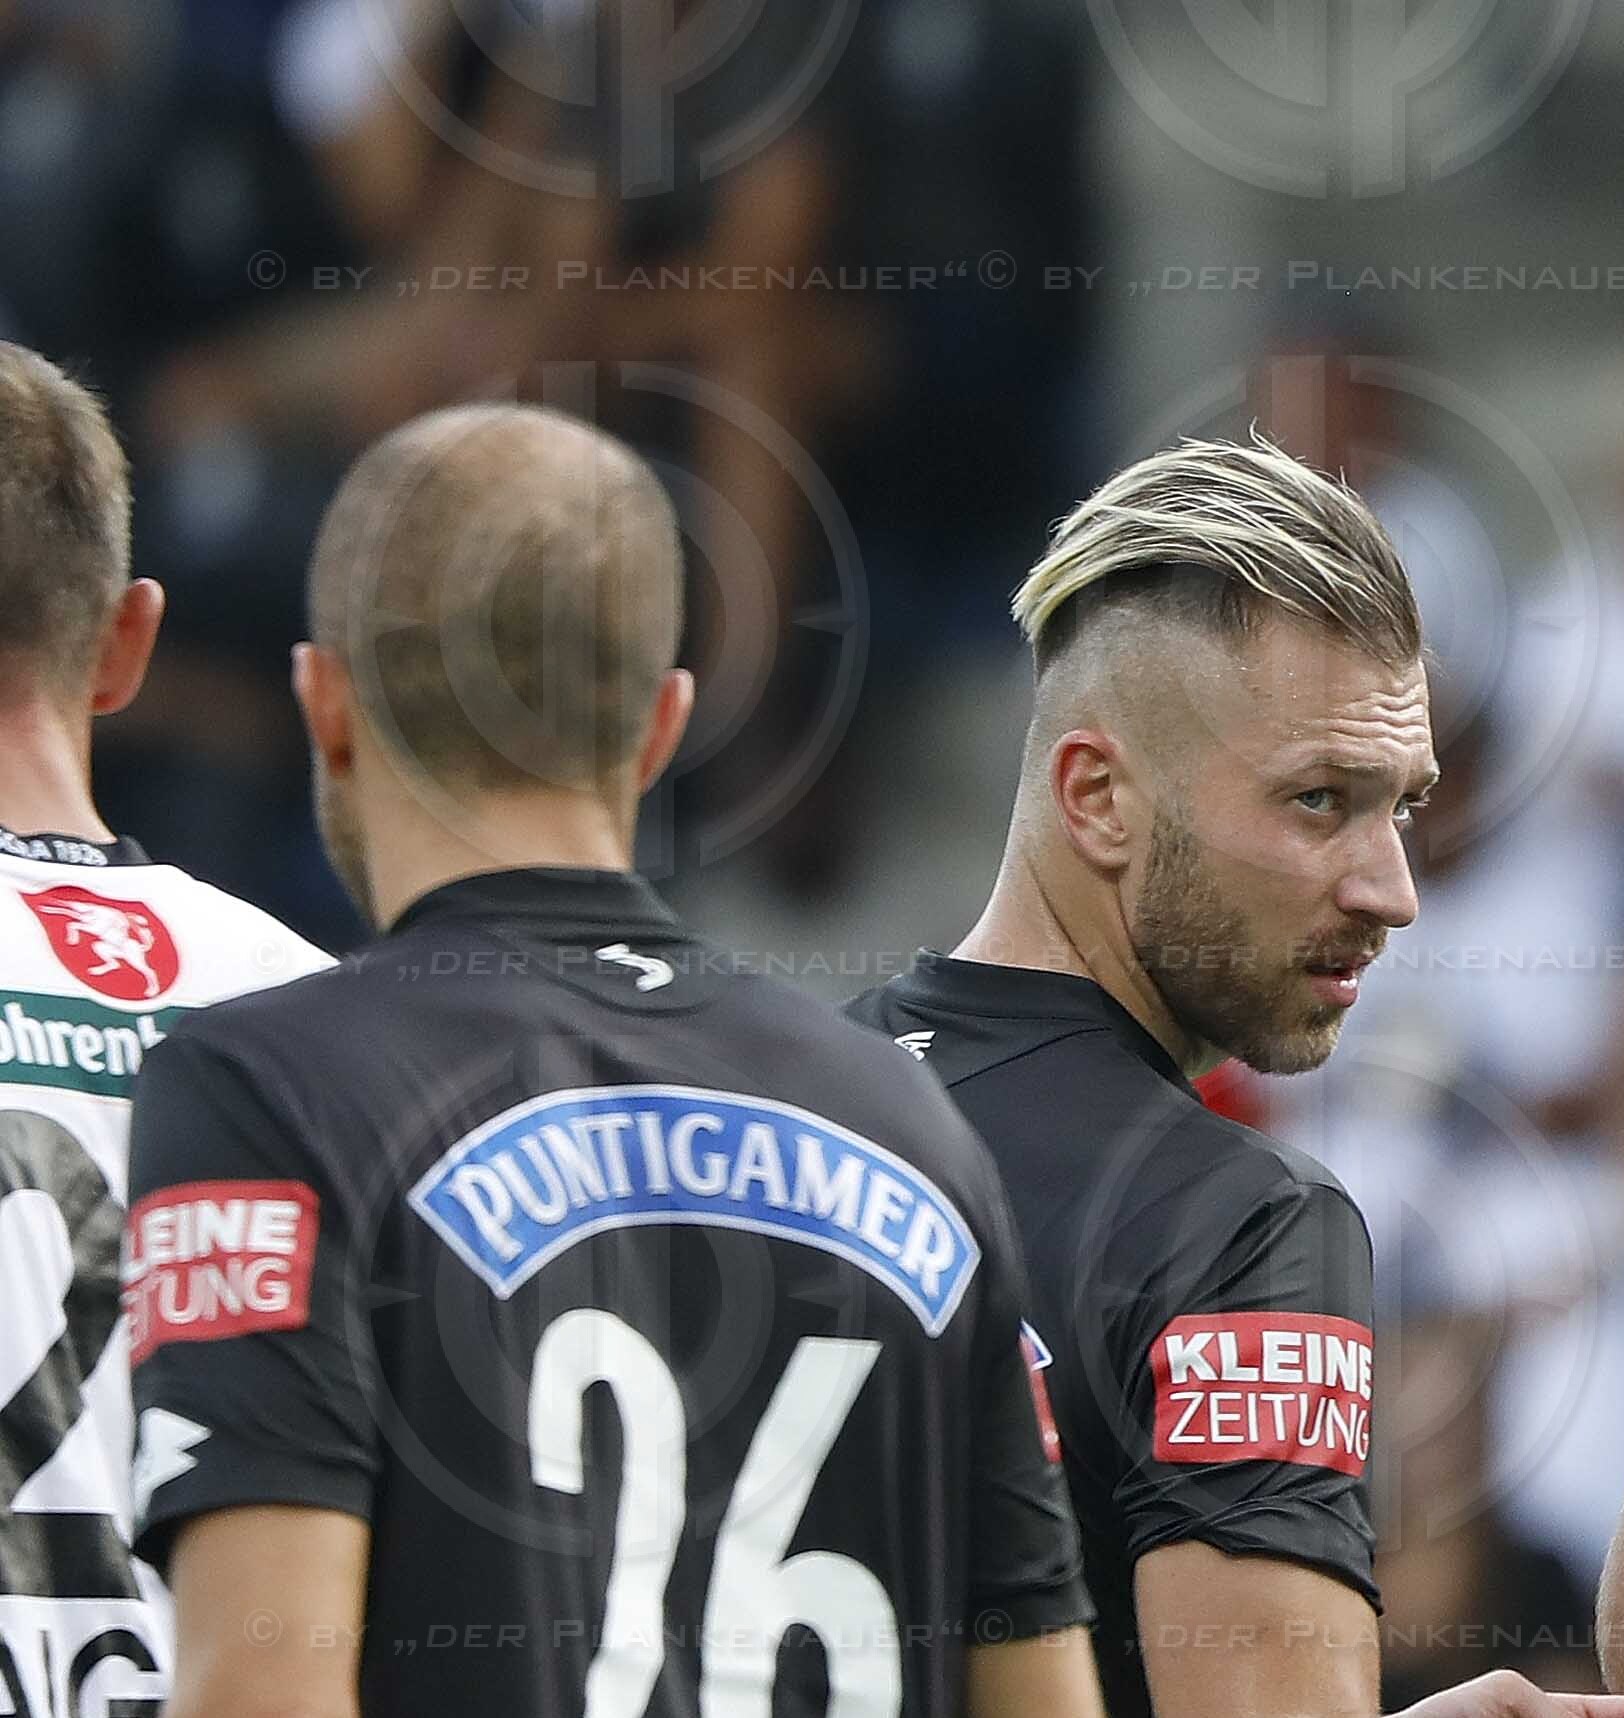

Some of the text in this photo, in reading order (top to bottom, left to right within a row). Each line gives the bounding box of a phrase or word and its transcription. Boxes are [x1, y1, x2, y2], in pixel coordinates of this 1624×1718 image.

[448, 1109, 957, 1296] PUNTIGAMER
[1165, 1331, 1373, 1398] KLEINE
[1168, 1392, 1370, 1462] ZEITUNG
